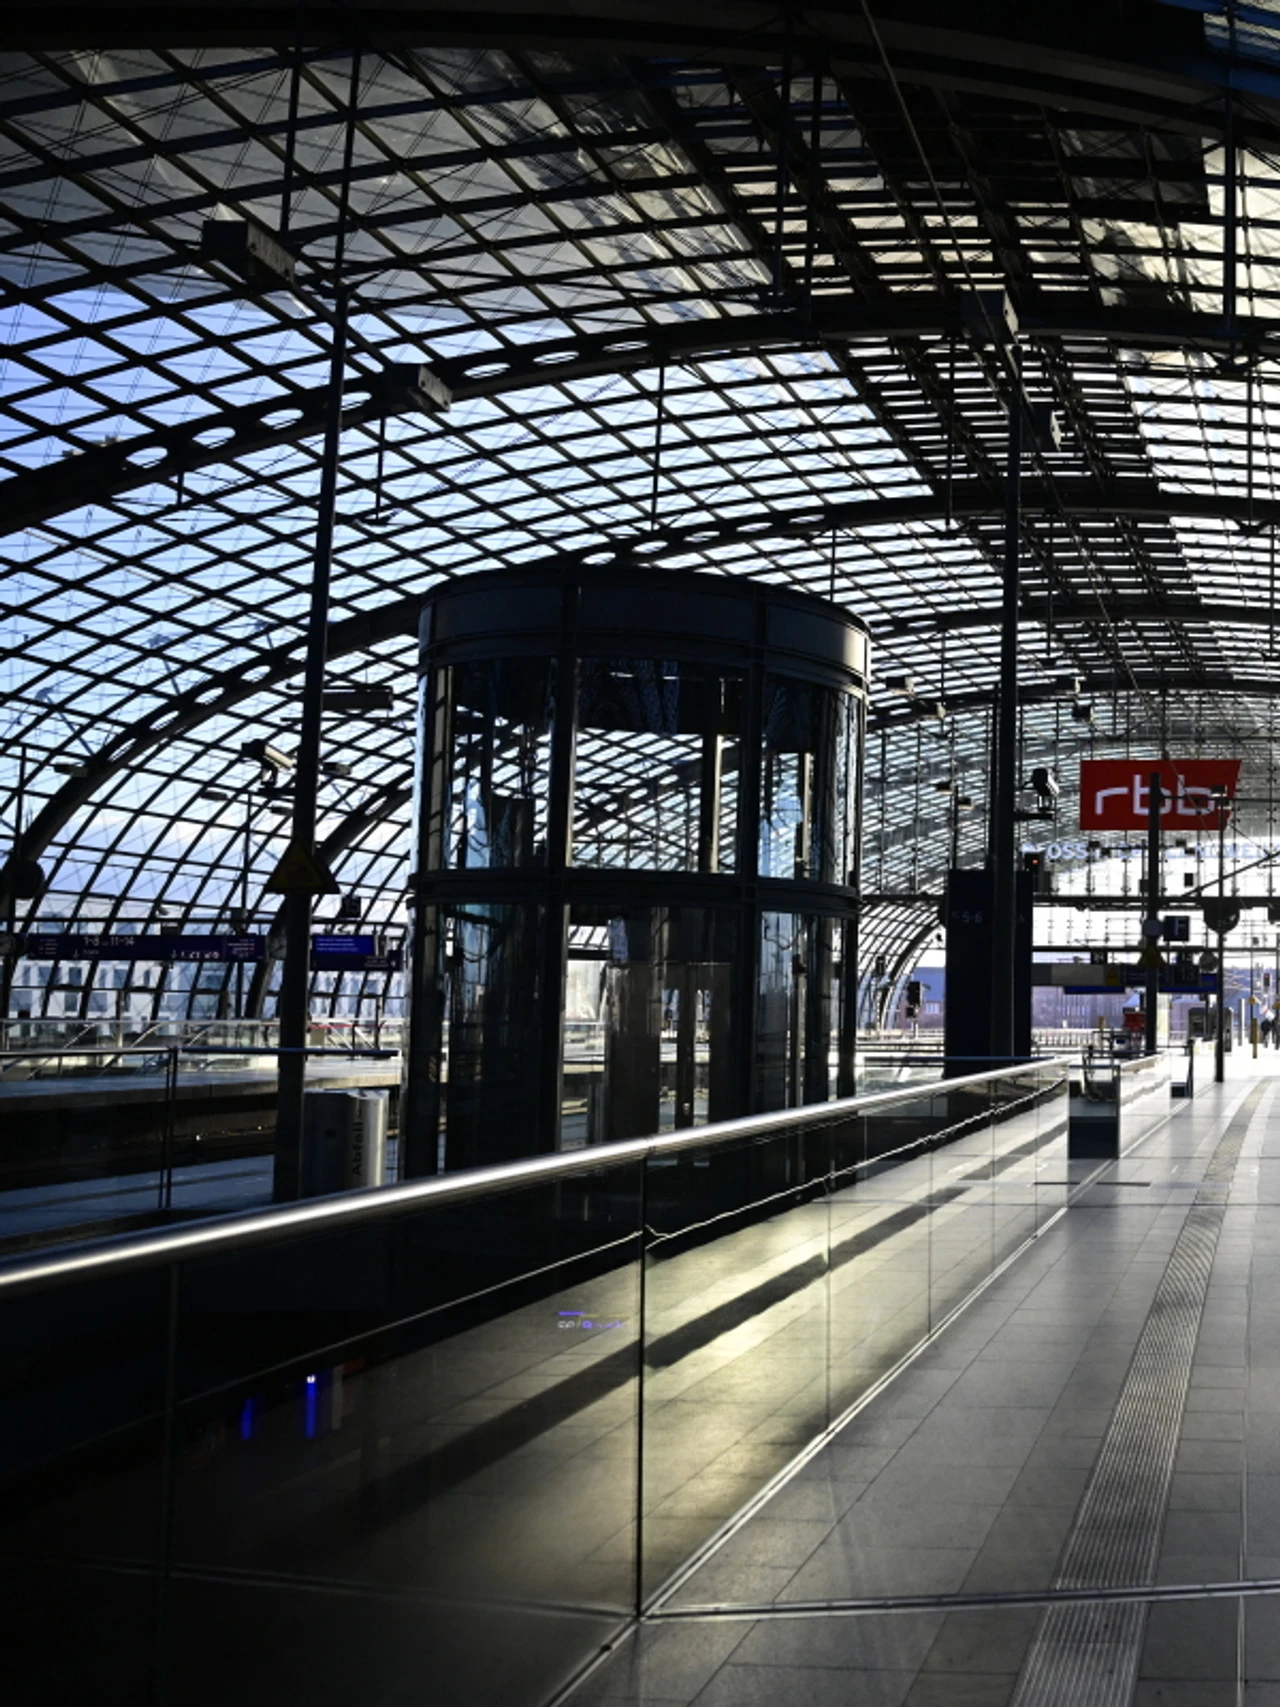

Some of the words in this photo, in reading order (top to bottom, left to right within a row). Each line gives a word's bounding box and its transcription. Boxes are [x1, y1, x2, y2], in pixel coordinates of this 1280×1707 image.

[1095, 774, 1216, 816] rbb
[1173, 917, 1186, 937] F
[1179, 966, 1196, 981] 13
[351, 1121, 364, 1176] Abfall
